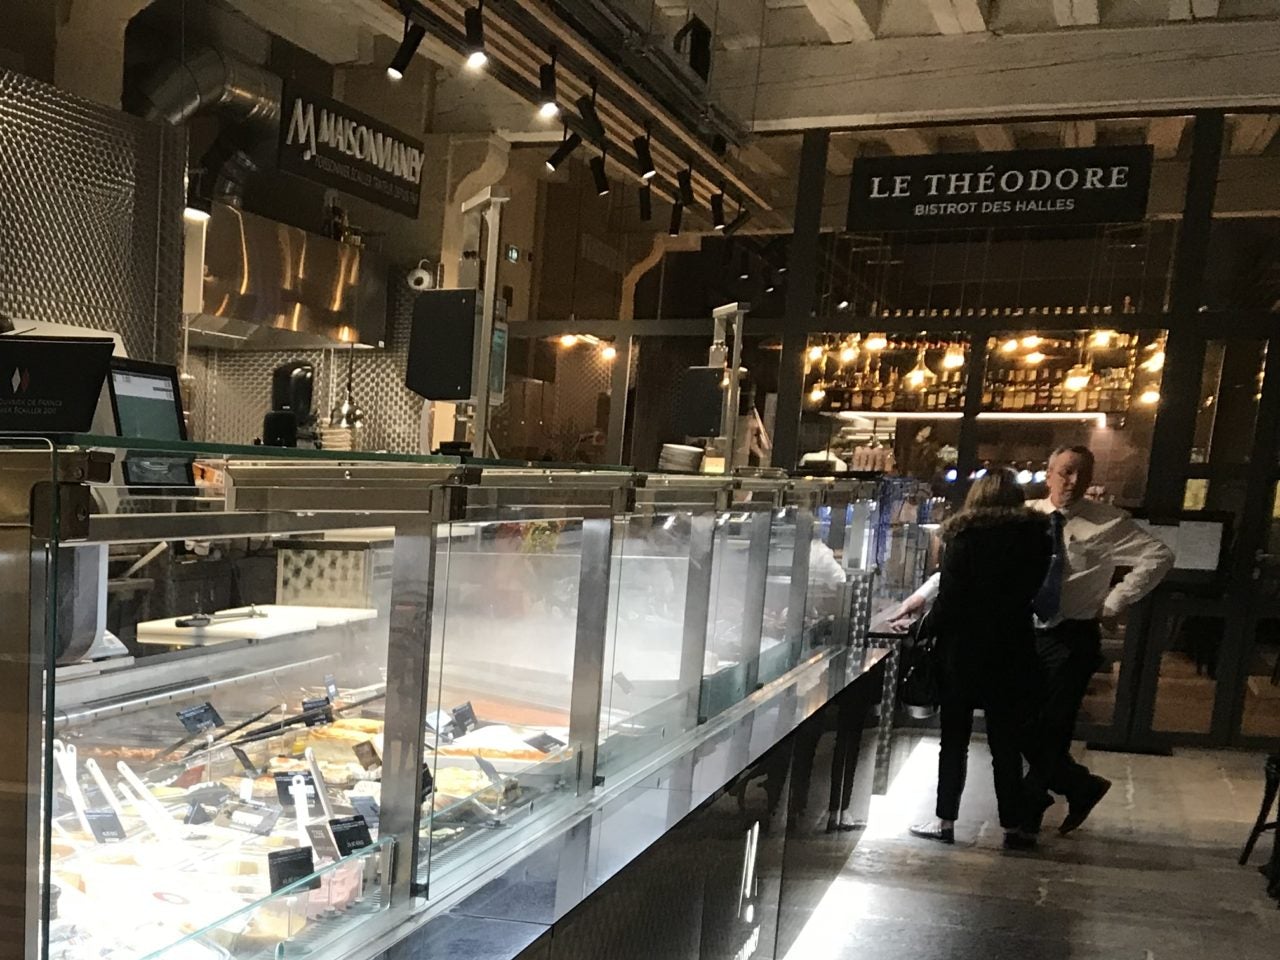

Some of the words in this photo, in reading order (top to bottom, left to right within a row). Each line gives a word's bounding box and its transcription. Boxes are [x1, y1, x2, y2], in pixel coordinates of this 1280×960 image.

[870, 175, 911, 198] LE
[923, 164, 1130, 196] THÉODORE
[914, 202, 978, 216] BISTROT
[981, 201, 1012, 214] DES
[1016, 199, 1075, 213] HALLES
